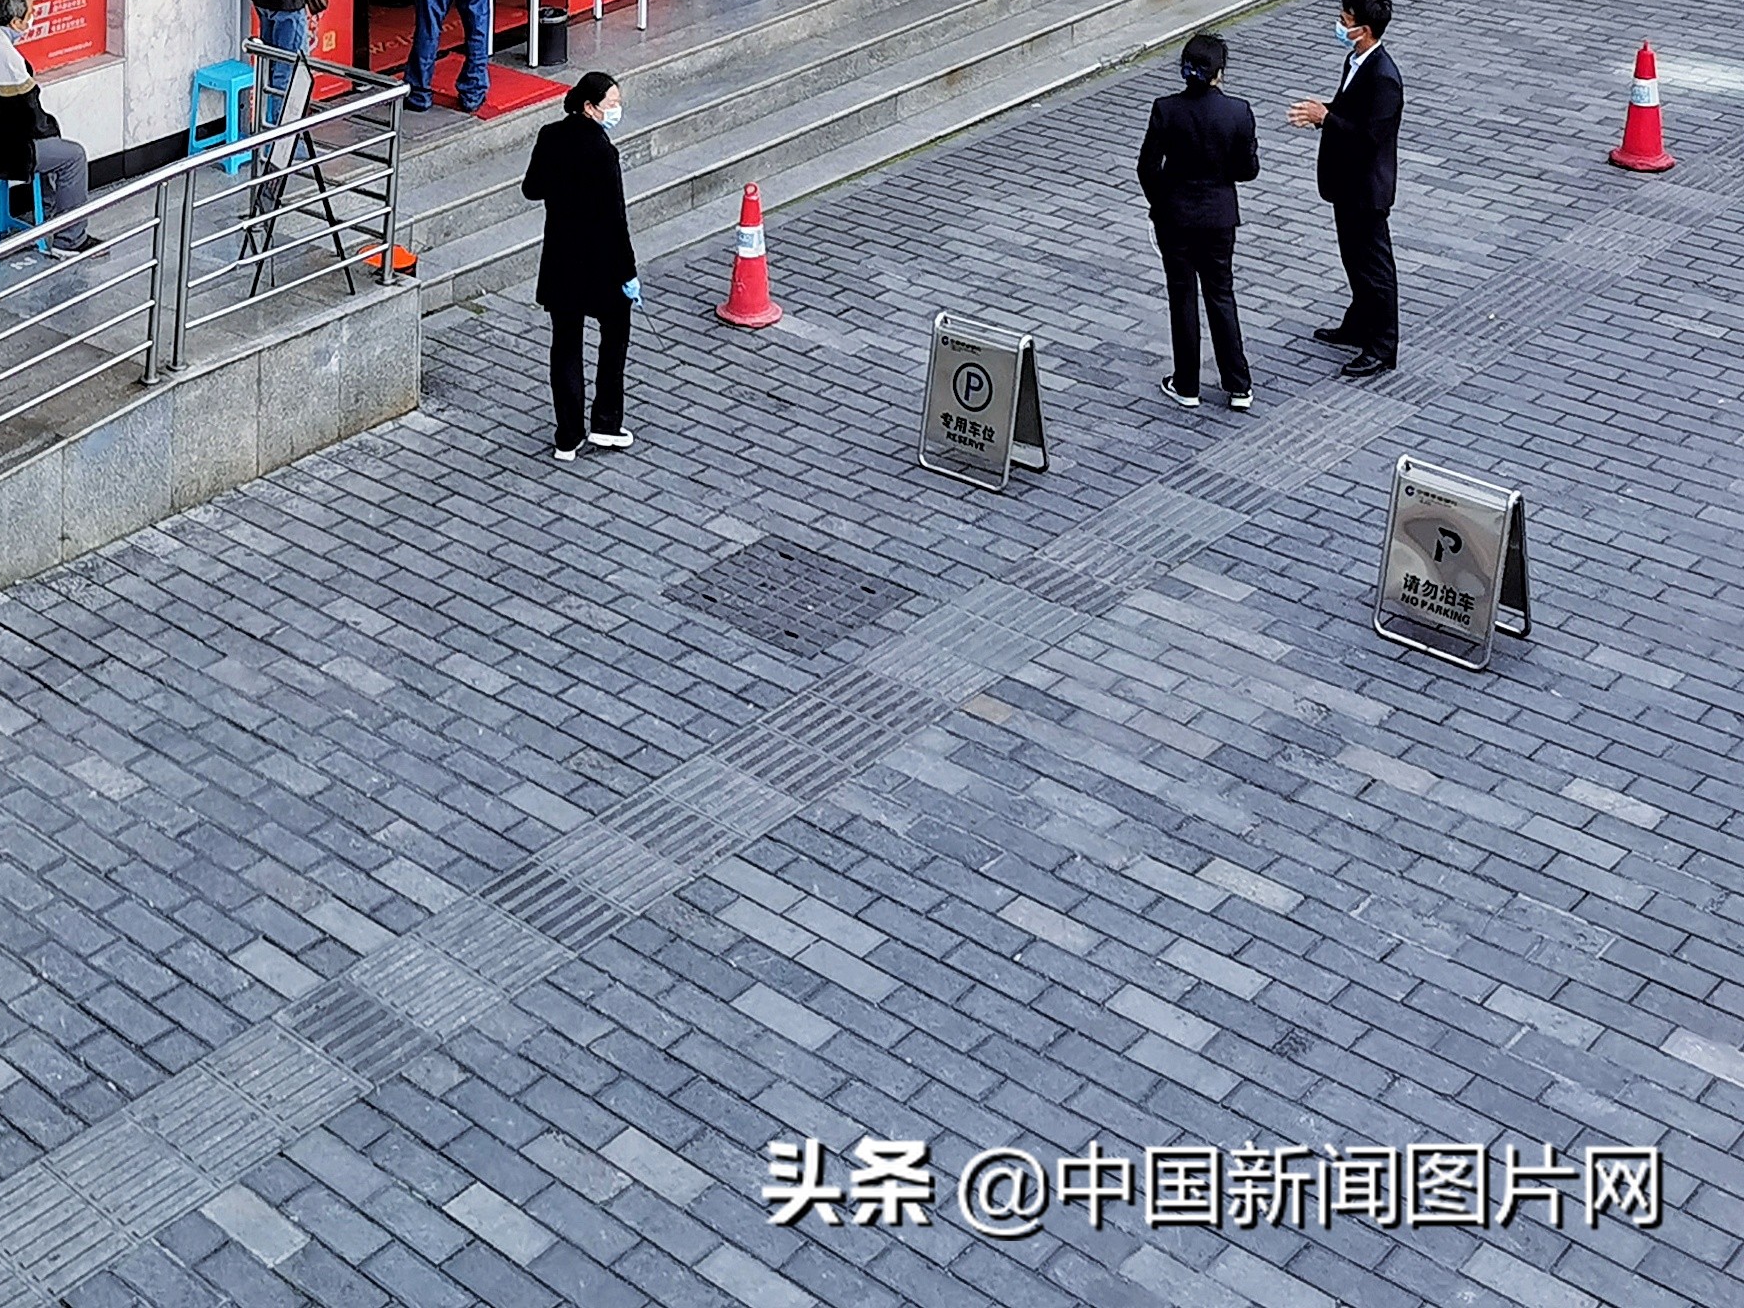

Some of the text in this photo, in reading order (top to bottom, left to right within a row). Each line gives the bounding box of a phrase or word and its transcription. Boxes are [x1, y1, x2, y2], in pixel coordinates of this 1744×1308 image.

[963, 371, 984, 402] P
[940, 412, 996, 444] 专用车位
[946, 430, 986, 452] RESERVE
[1432, 526, 1463, 563] P
[1400, 592, 1471, 627] NO PARKING
[1403, 573, 1476, 613] 请勿泊车
